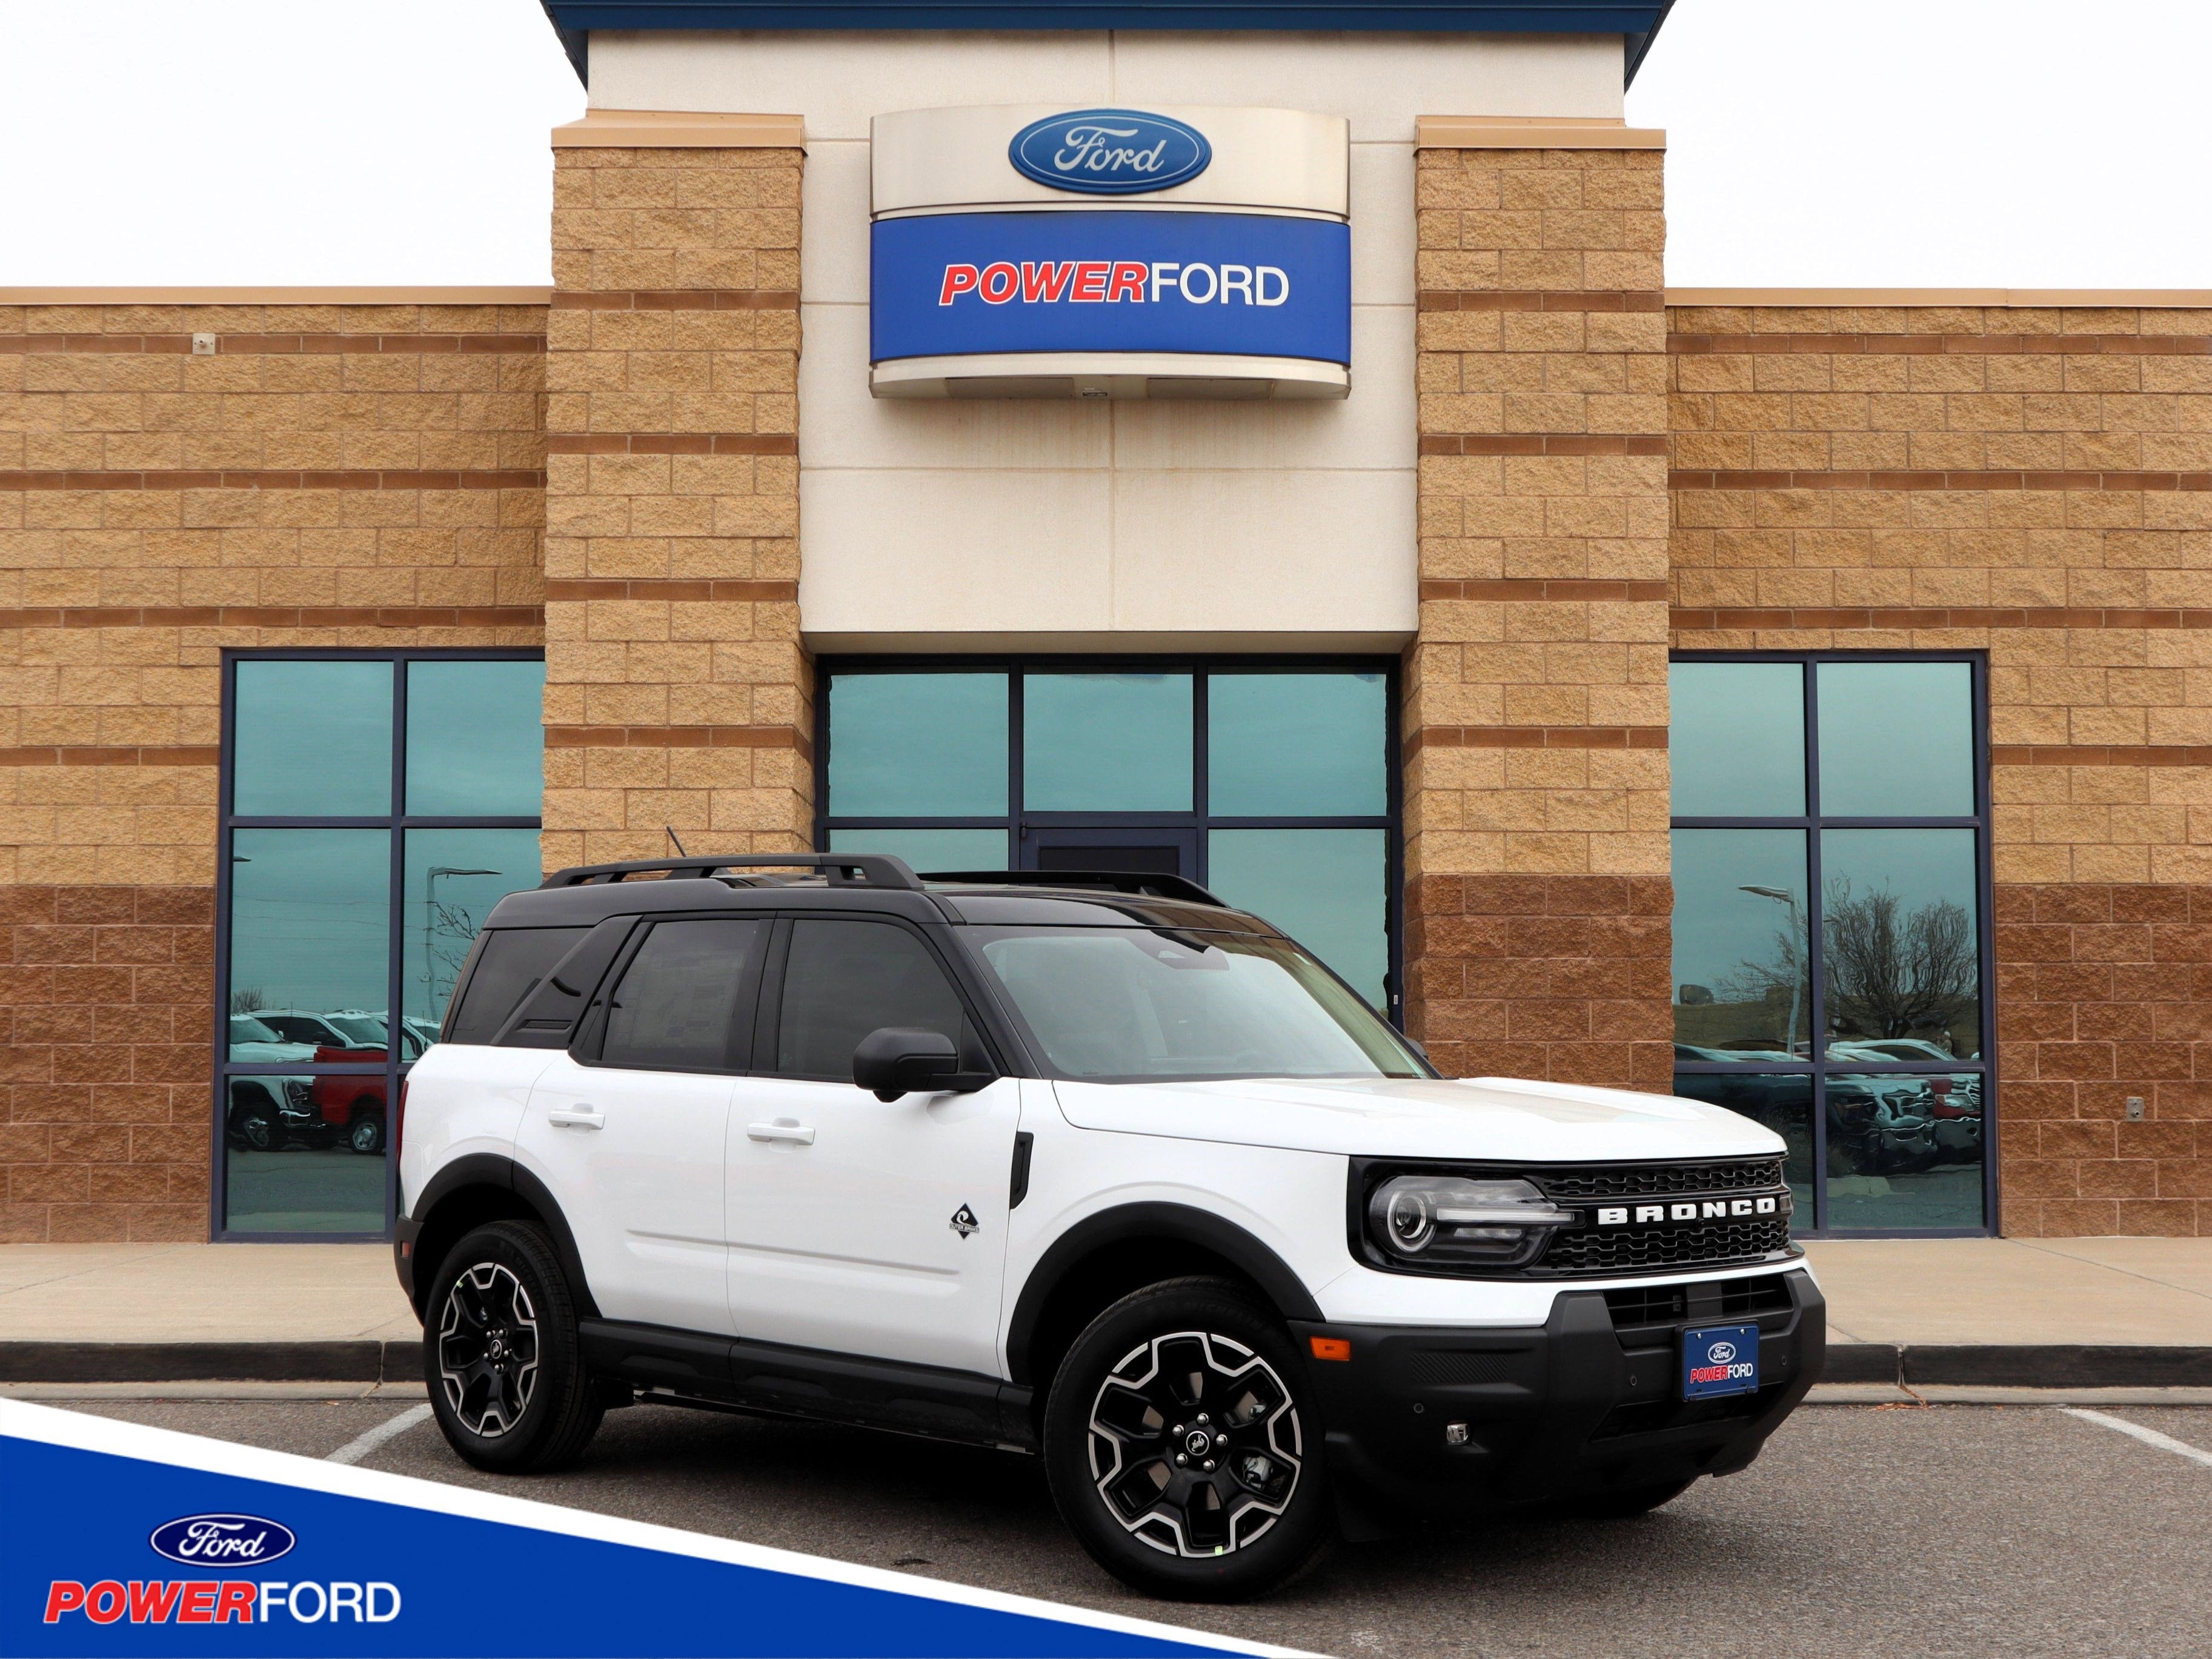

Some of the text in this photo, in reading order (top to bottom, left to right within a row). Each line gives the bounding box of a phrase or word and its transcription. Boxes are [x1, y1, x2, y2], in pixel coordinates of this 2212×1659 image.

[1054, 125, 1167, 172] Ford
[1598, 1197, 1776, 1225] BRONCO
[1713, 1346, 1730, 1359] Ford
